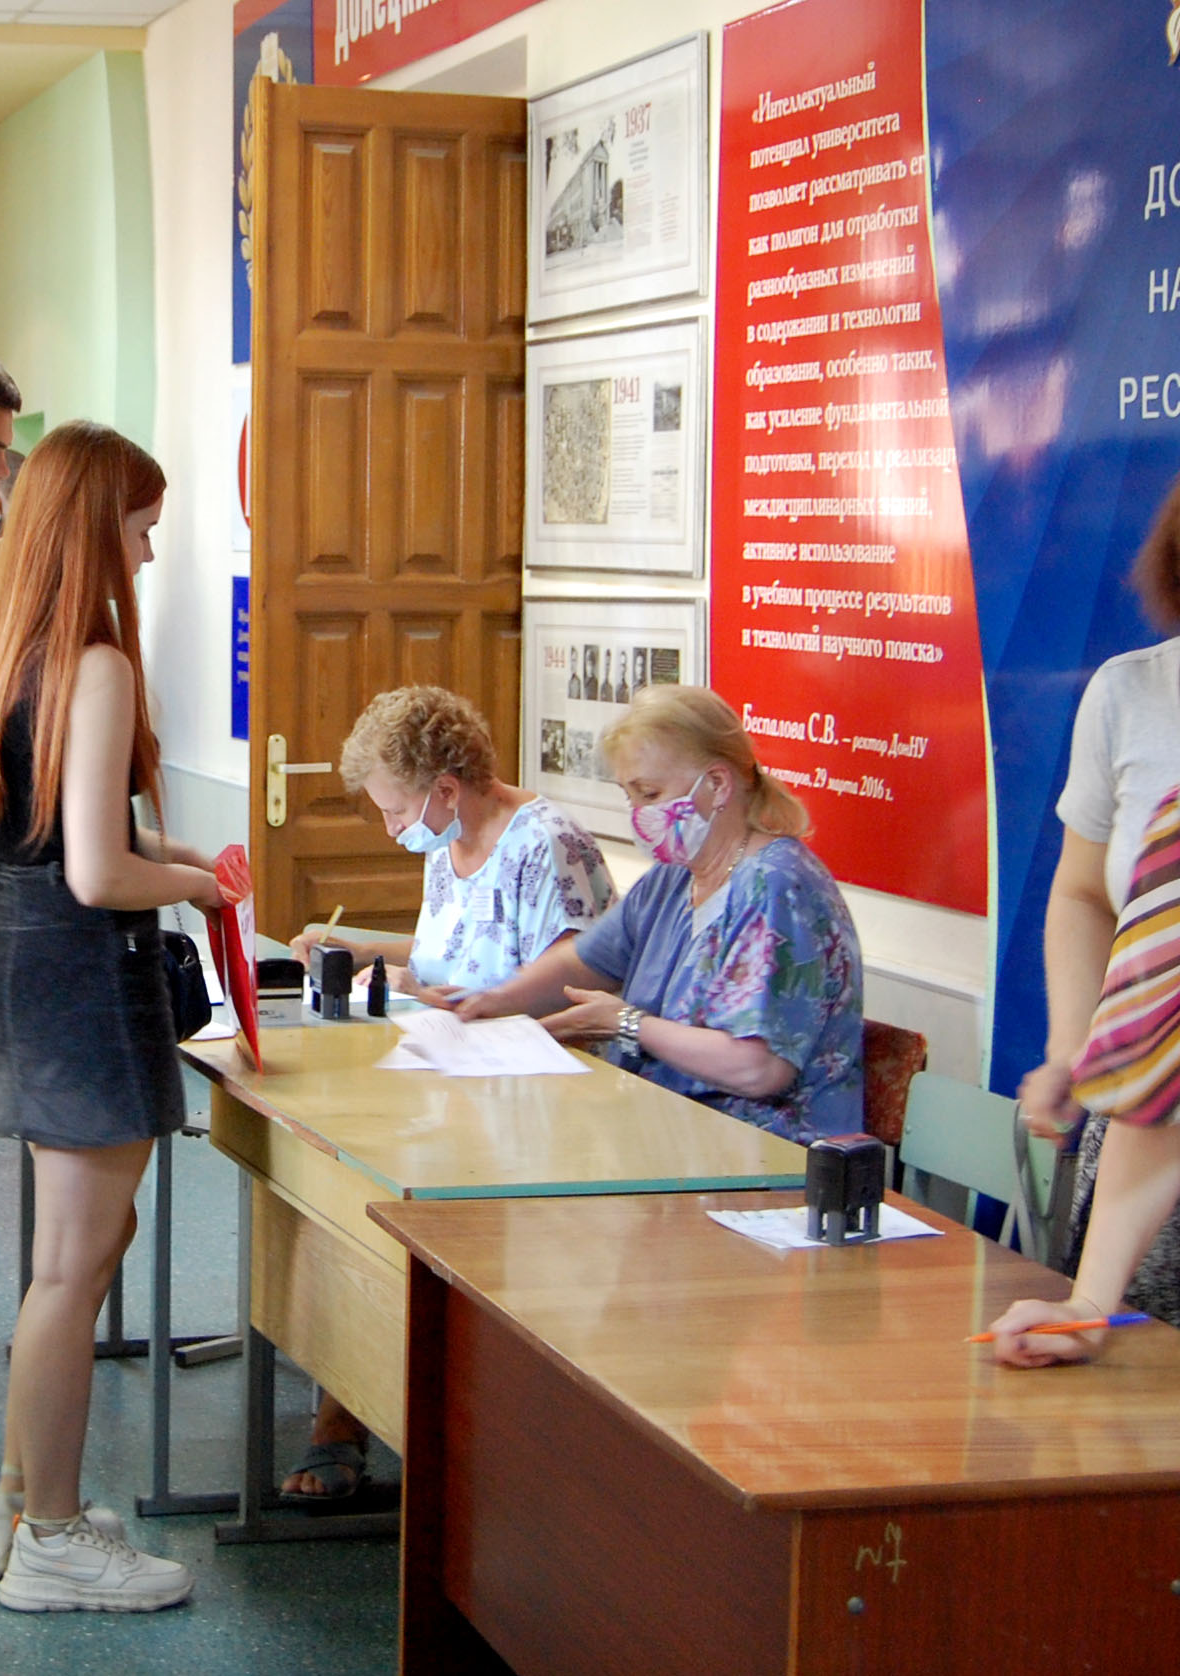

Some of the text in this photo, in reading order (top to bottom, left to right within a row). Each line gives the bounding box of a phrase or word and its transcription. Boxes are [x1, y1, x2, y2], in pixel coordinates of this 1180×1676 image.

[752, 61, 876, 123] «Интеллектуальный
[624, 102, 652, 138] 1937
[750, 112, 901, 169] потенциал университета
[749, 154, 925, 213] позволяет рассматривать ег
[748, 203, 919, 256] как полигон для отработки
[747, 244, 915, 306] разнообразных изменений
[746, 302, 921, 345] в содержании и технологии
[613, 376, 640, 404] 1941
[745, 350, 937, 392] образования, особенно таких,
[745, 387, 950, 435] как усиление фундаментальной
[744, 452, 816, 475] подготовки,
[743, 498, 875, 523] междисциплинарных
[743, 542, 896, 563] активное использование
[742, 579, 952, 618] в учебном процессе результатов
[741, 625, 944, 664] и технологий научного поиска»
[743, 703, 806, 741] Беспалова
[808, 712, 839, 745] С.В.
[888, 733, 929, 759] ДонНУ
[813, 767, 828, 788] 29
[859, 776, 884, 800] 2016
